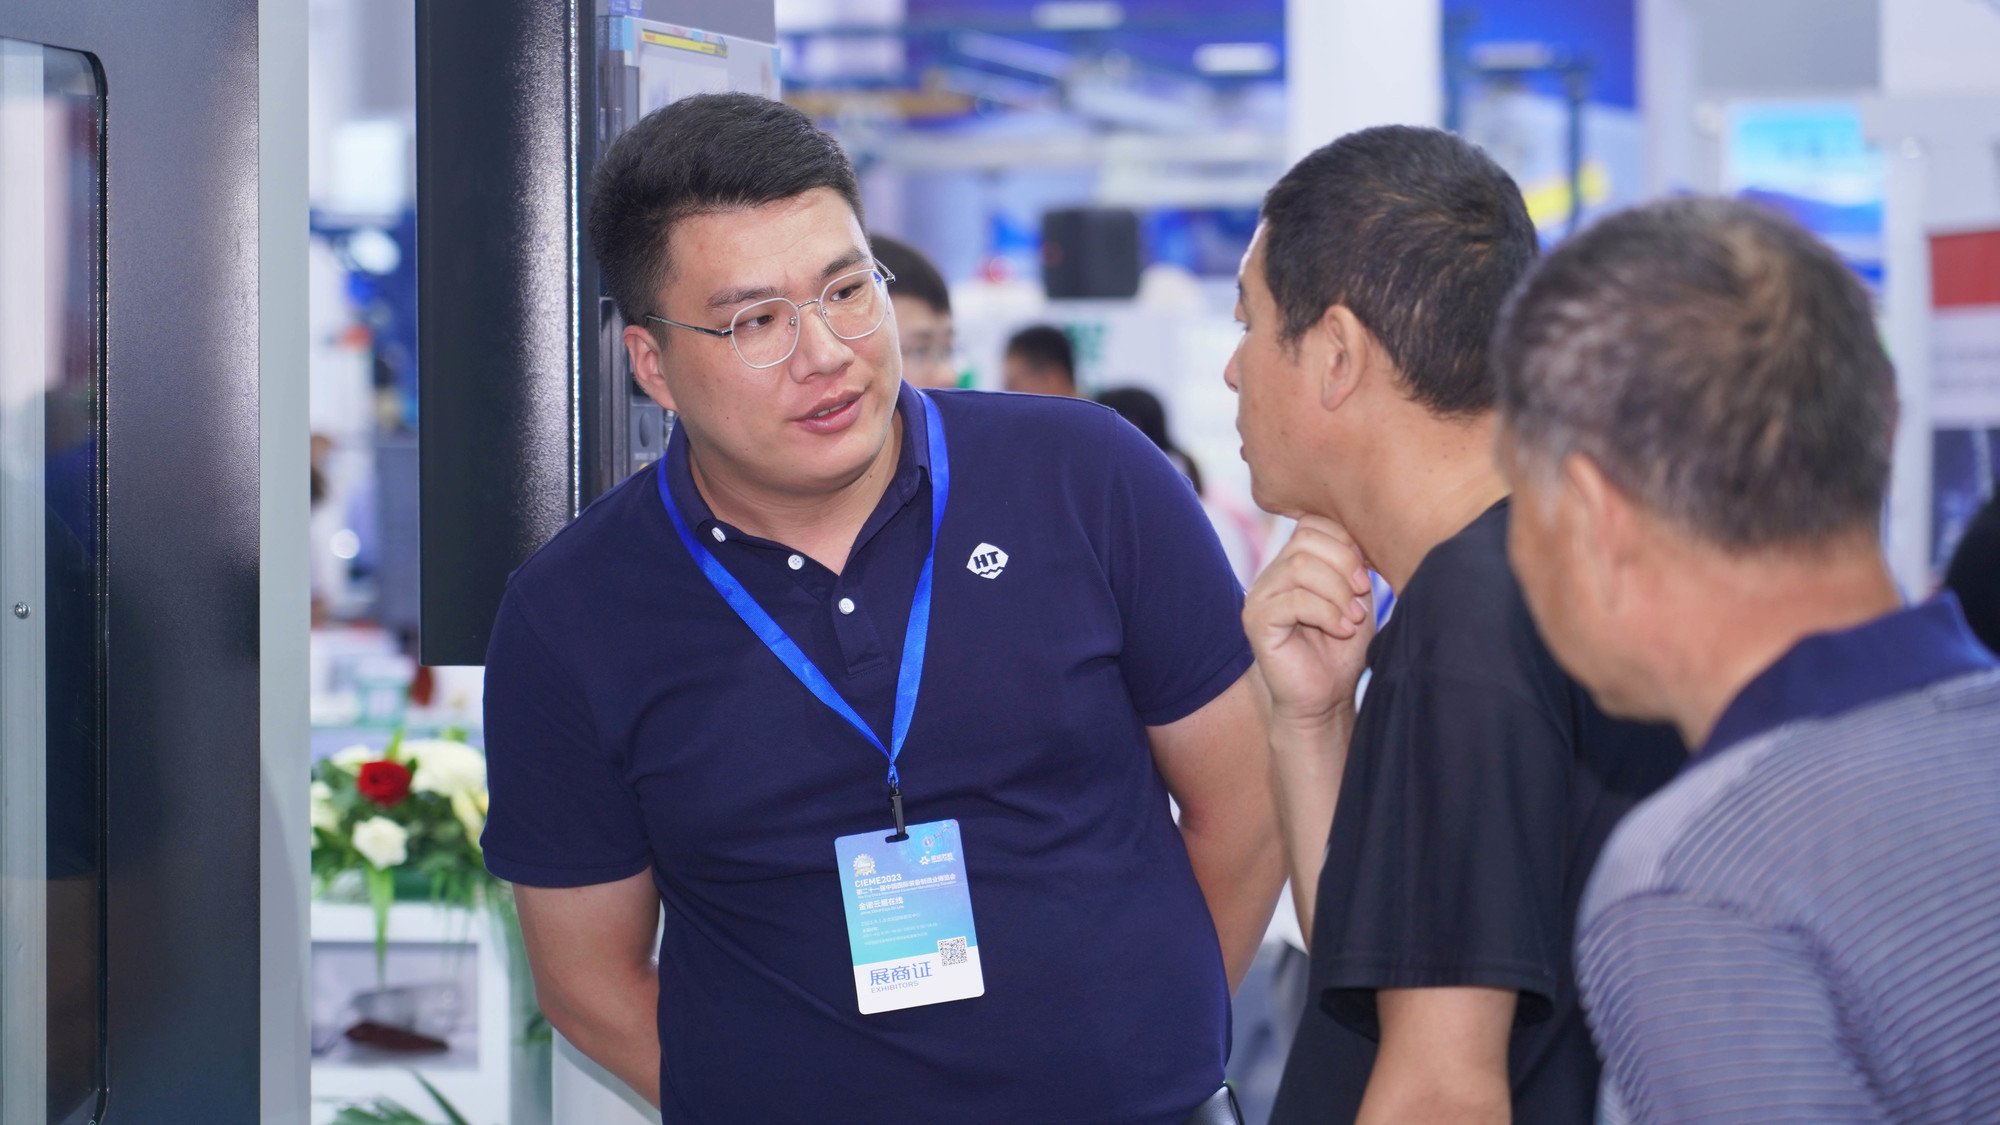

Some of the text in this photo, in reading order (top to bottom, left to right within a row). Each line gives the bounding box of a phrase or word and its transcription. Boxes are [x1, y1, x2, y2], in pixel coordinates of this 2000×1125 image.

[973, 551, 999, 569] HT
[855, 873, 902, 888] CIEME2023
[870, 961, 933, 986] 展商证
[871, 981, 919, 993] EXHIBITORS
